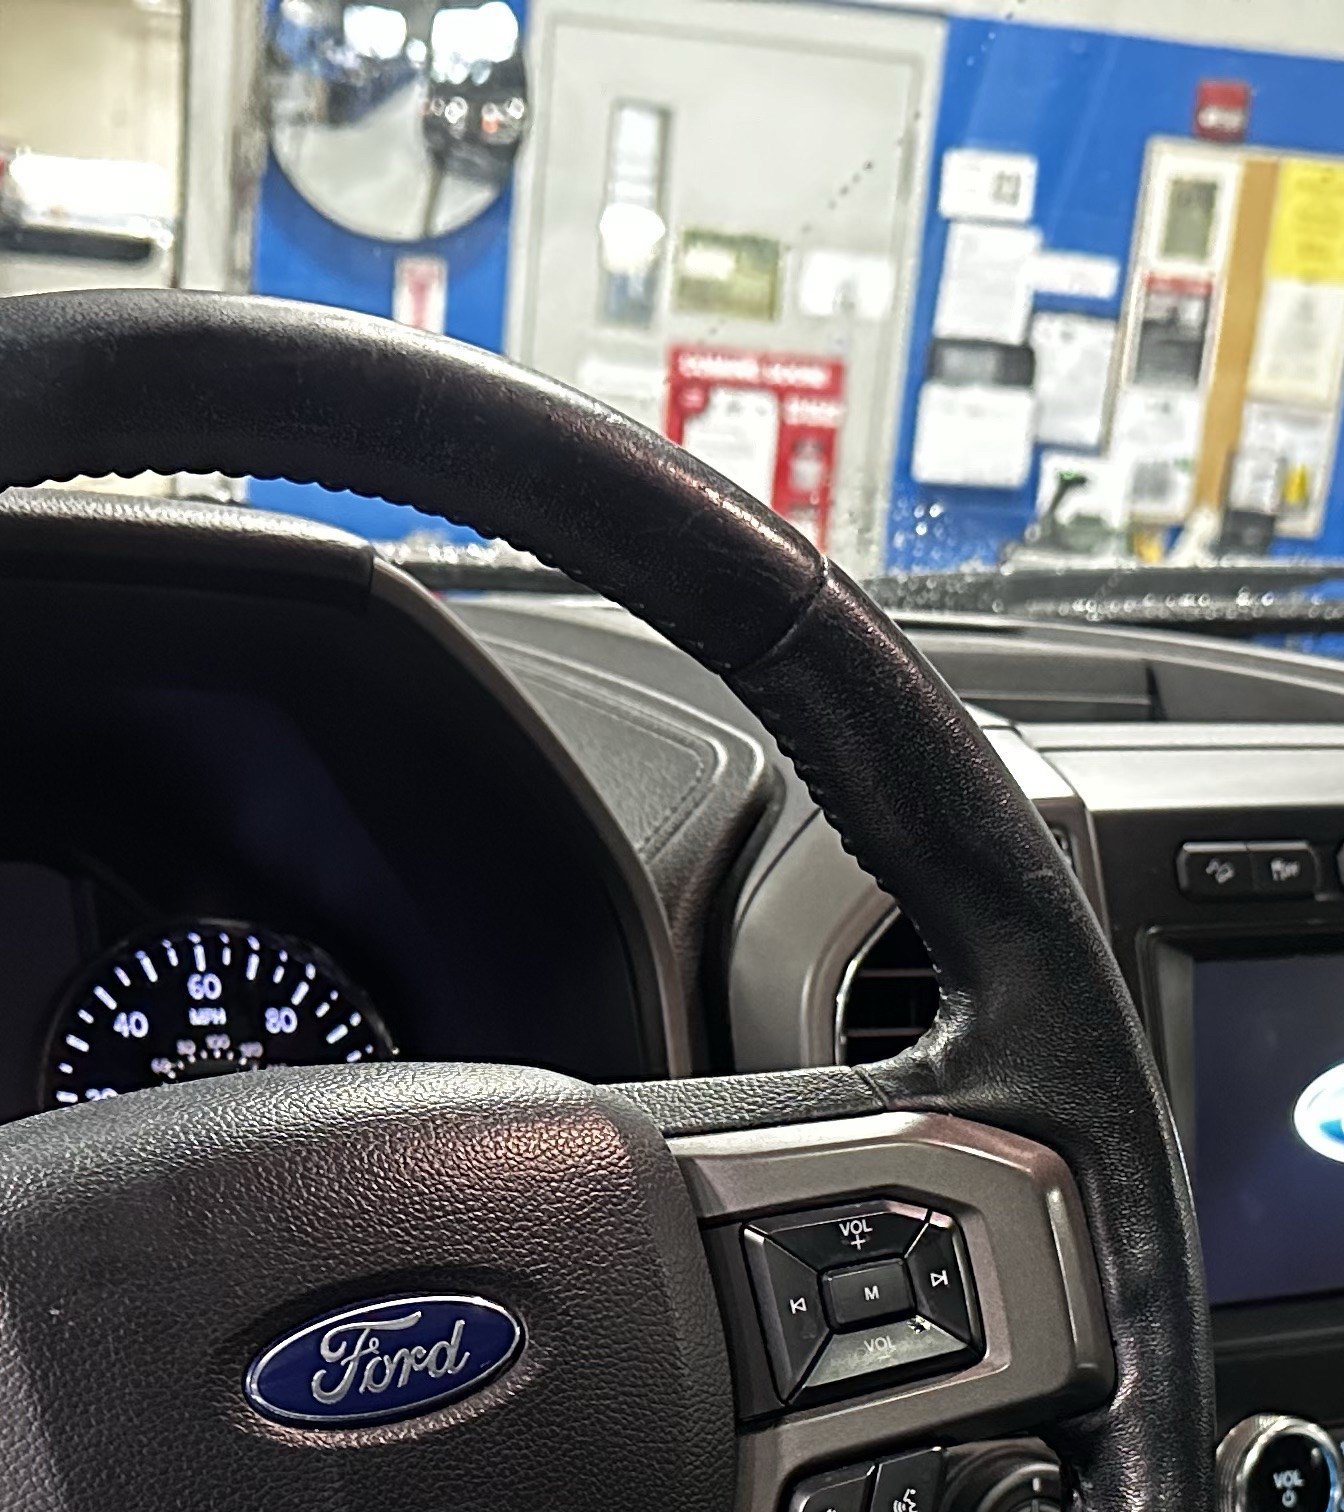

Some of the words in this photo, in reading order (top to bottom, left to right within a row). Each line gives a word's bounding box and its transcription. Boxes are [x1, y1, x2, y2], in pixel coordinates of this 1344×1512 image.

[187, 973, 222, 1000] 60
[113, 1011, 149, 1038] 40
[264, 1007, 298, 1034] 80
[839, 1219, 873, 1237] VOL
[864, 1285, 880, 1301] M
[864, 1335, 897, 1353] VOL
[311, 1311, 470, 1404] Ford
[1273, 1469, 1304, 1489] VOL
